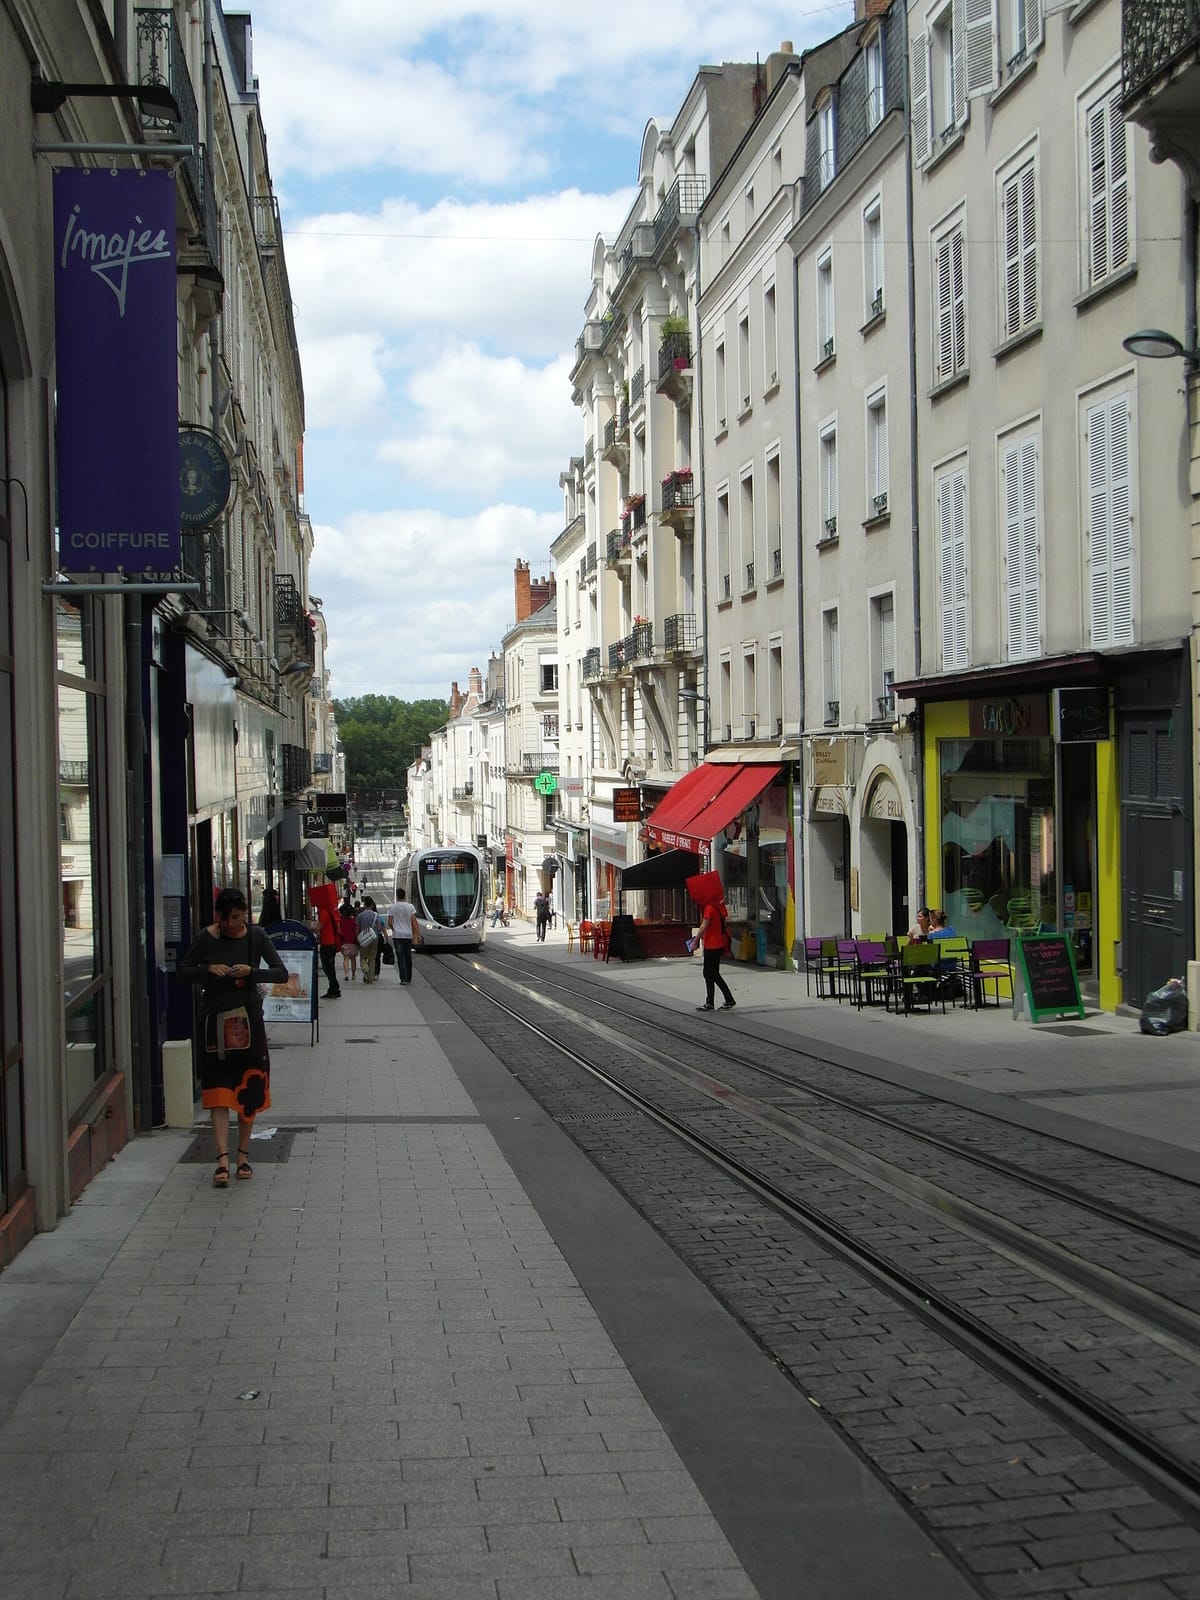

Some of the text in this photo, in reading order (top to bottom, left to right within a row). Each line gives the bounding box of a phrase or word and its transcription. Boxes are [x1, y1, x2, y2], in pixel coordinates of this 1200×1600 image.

[203, 441, 224, 471] Barry
[70, 532, 170, 548] COIFFURE
[817, 798, 834, 810] COIFFURE
[306, 816, 325, 826] PM
